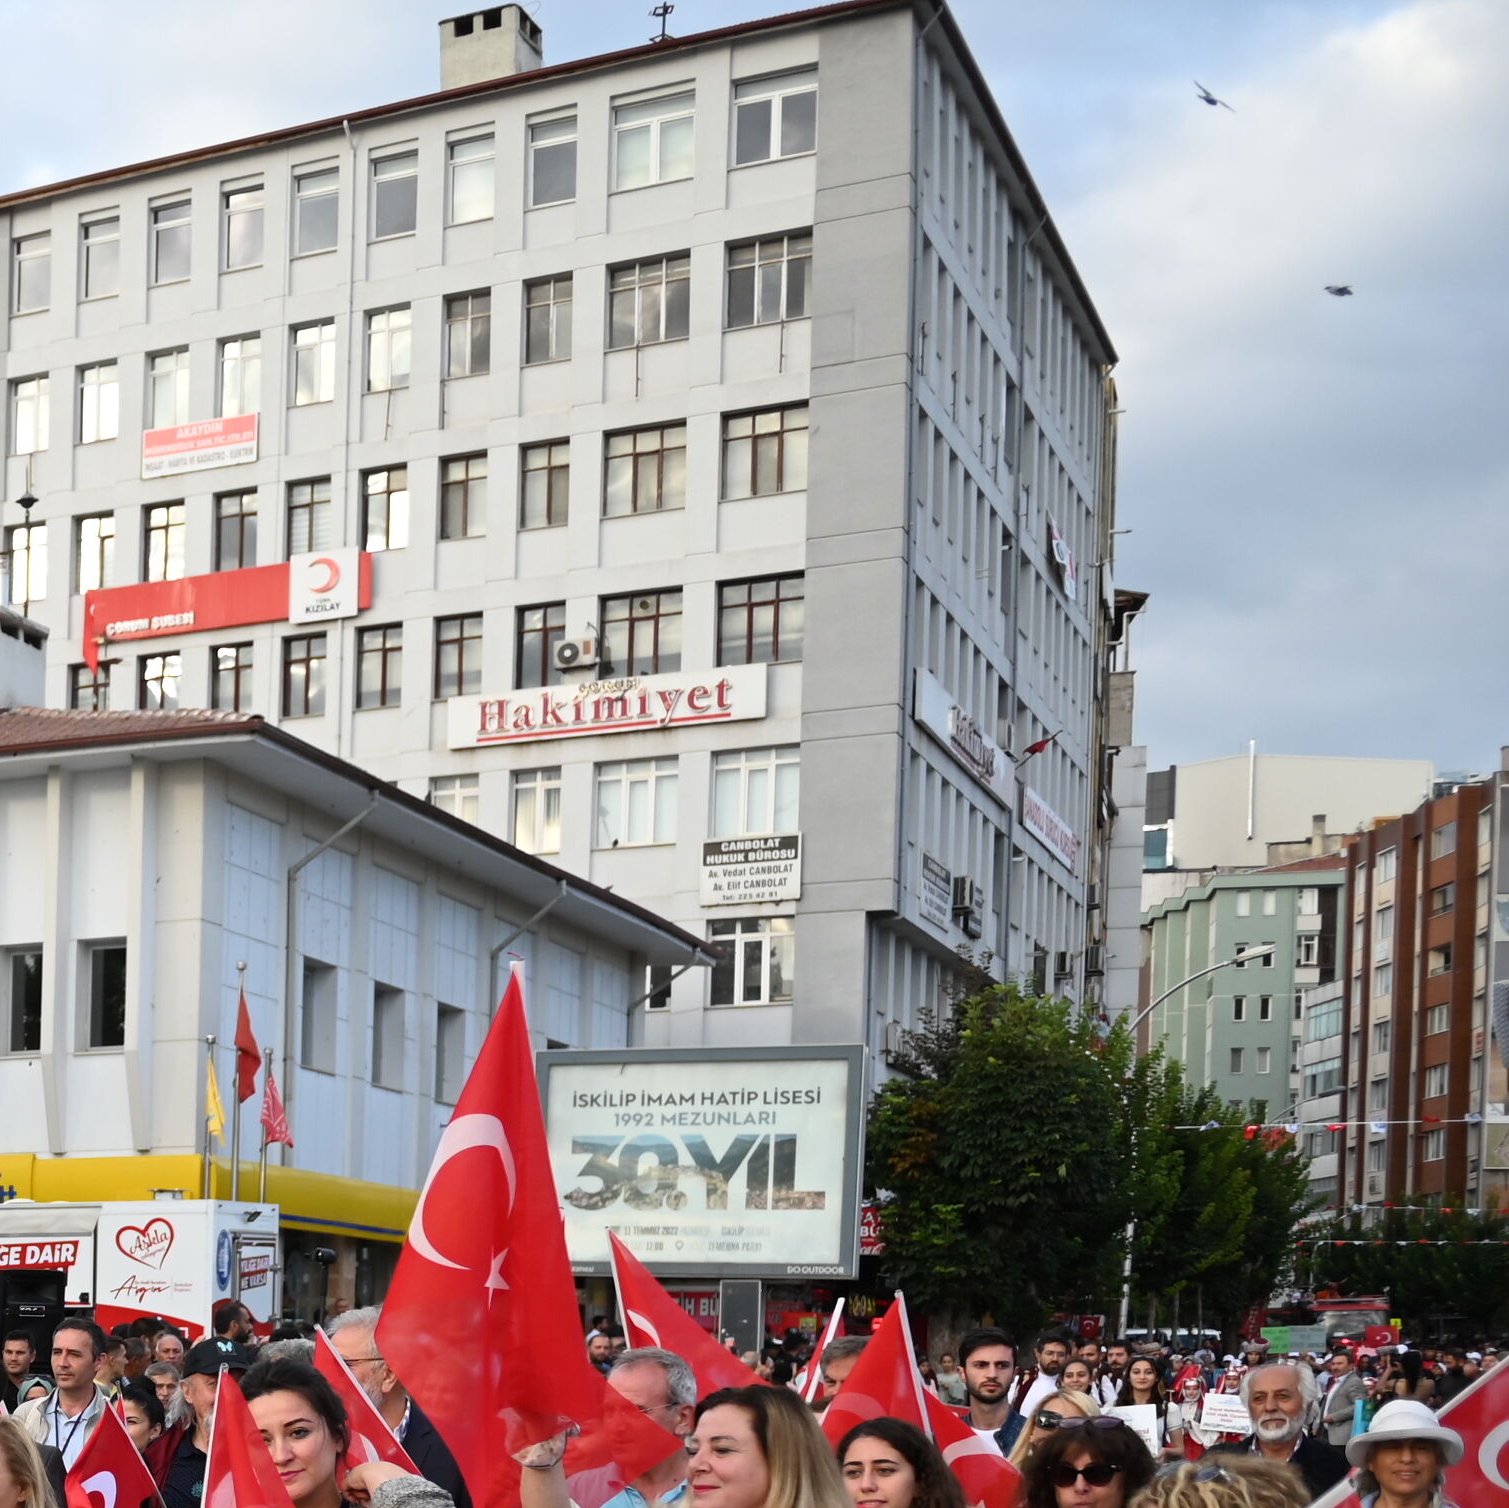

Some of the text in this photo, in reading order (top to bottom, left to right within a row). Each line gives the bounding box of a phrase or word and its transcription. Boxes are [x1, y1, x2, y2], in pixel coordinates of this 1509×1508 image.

[305, 601, 341, 614] KIZILAY
[477, 677, 733, 729] Hakimiyet
[721, 838, 781, 852] CANBOLAT
[706, 848, 796, 865] HUKUK BÜROSU
[708, 863, 794, 879] Av. Vedat CANBOLAT
[727, 880, 741, 891] Elif
[743, 877, 788, 890] CANBOLAT
[572, 1086, 822, 1108] İSKİLİP İMAM HATİP LİSESİ
[614, 1111, 777, 1128] 1992 MEZUNLARI
[25, 1243, 75, 1265] DAİR
[801, 1266, 845, 1275] OUTDOOR
